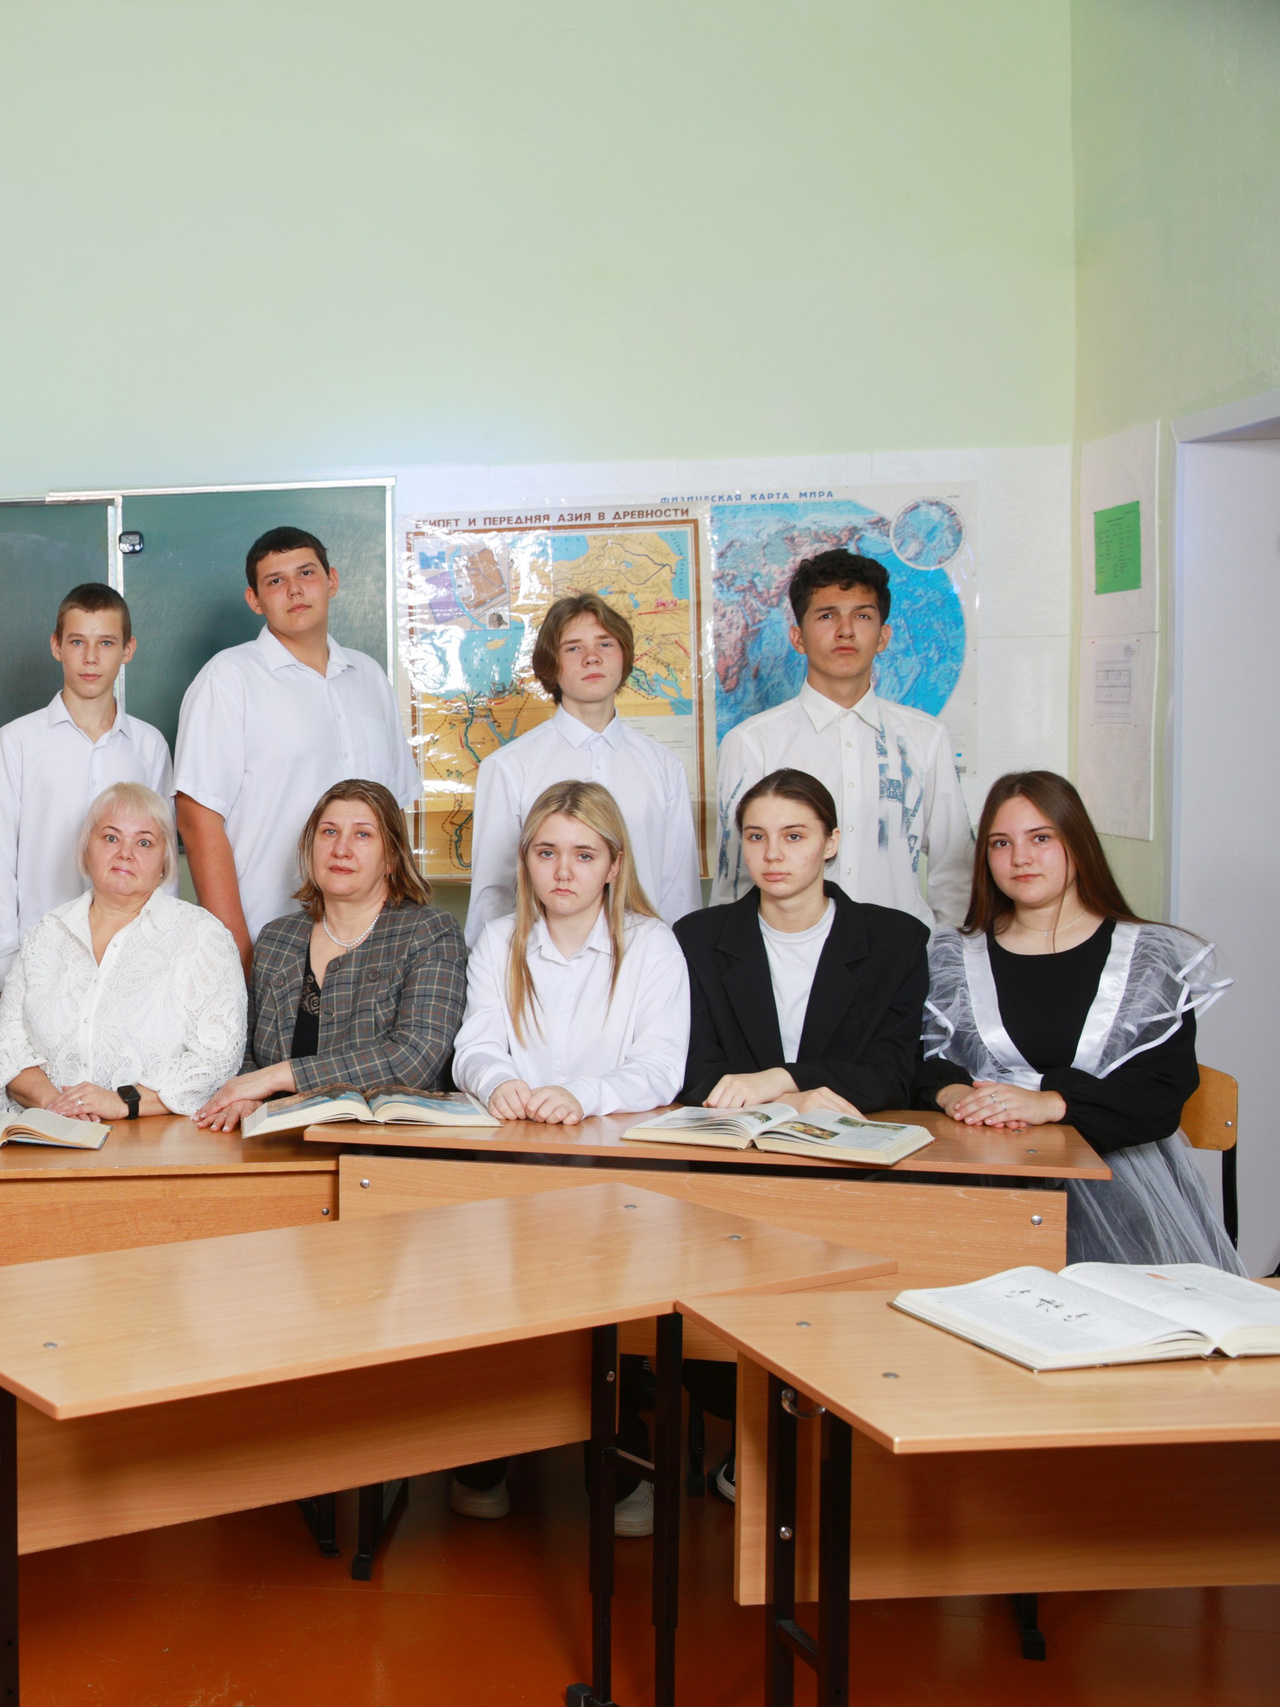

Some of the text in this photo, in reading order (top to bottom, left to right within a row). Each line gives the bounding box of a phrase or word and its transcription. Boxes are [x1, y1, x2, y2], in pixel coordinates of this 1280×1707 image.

[750, 492, 789, 501] КАРТА
[799, 490, 834, 499] МИРА
[468, 518, 477, 527] И
[483, 514, 550, 526] ПЕРЕДНЯЯ
[557, 512, 591, 522] АЗИЯ
[598, 512, 605, 520] В
[612, 508, 689, 520] ДРЕВНОСТИ
